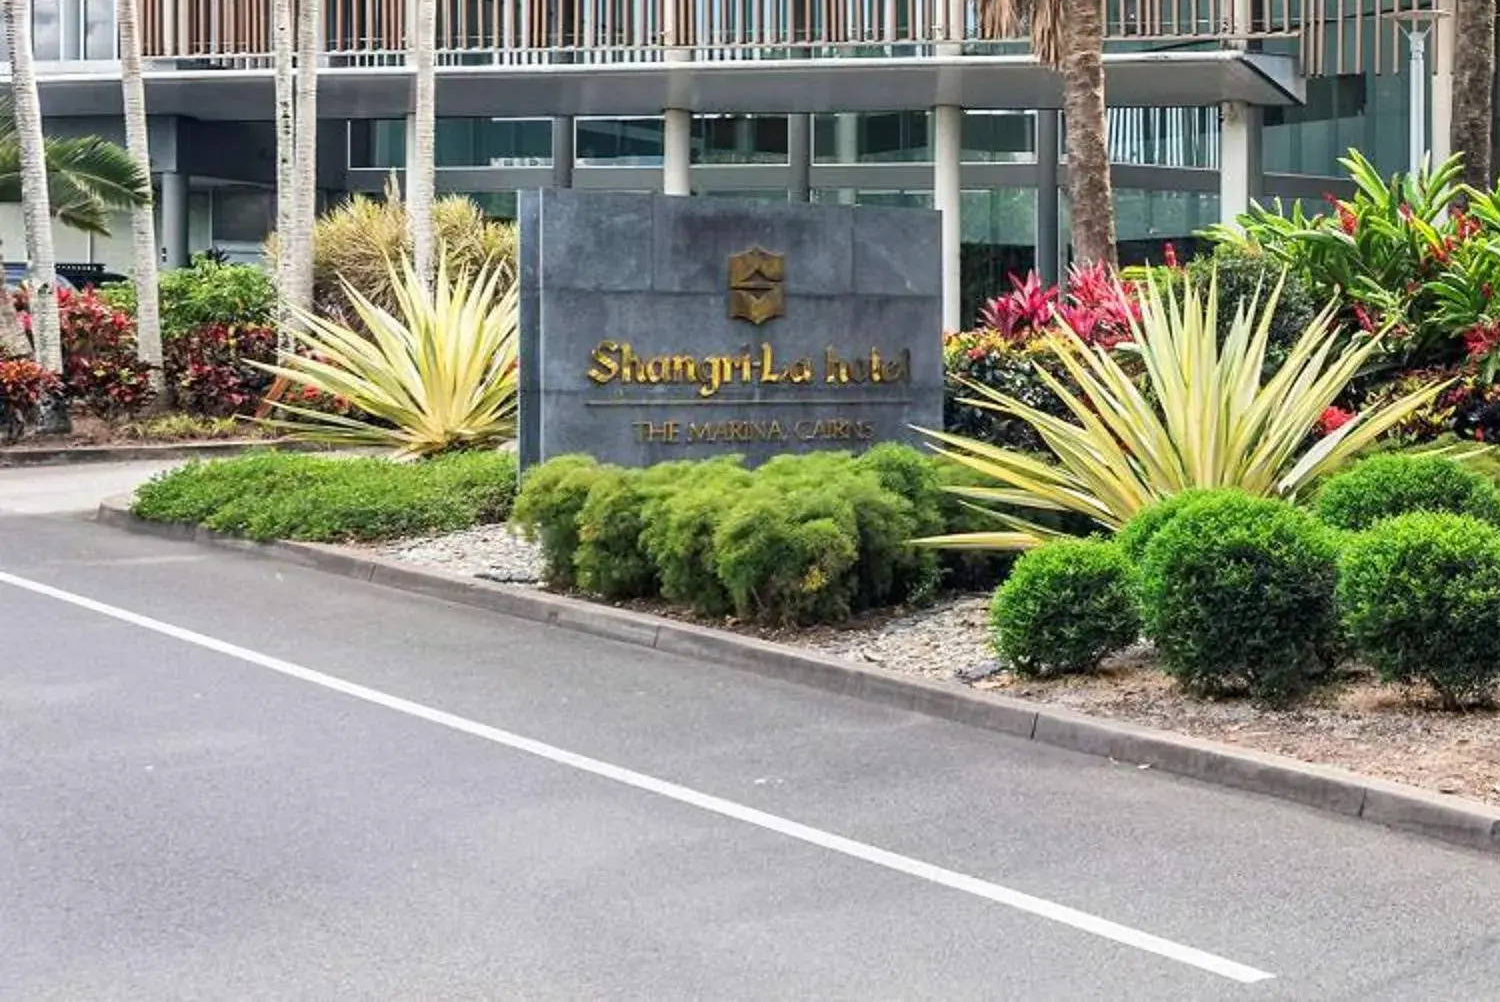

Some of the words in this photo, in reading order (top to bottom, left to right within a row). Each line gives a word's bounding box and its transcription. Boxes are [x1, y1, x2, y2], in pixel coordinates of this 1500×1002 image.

[587, 340, 812, 397] Shangri-La
[825, 344, 912, 384] hotel
[632, 420, 680, 443] THE
[794, 418, 875, 441] CAIRNS
